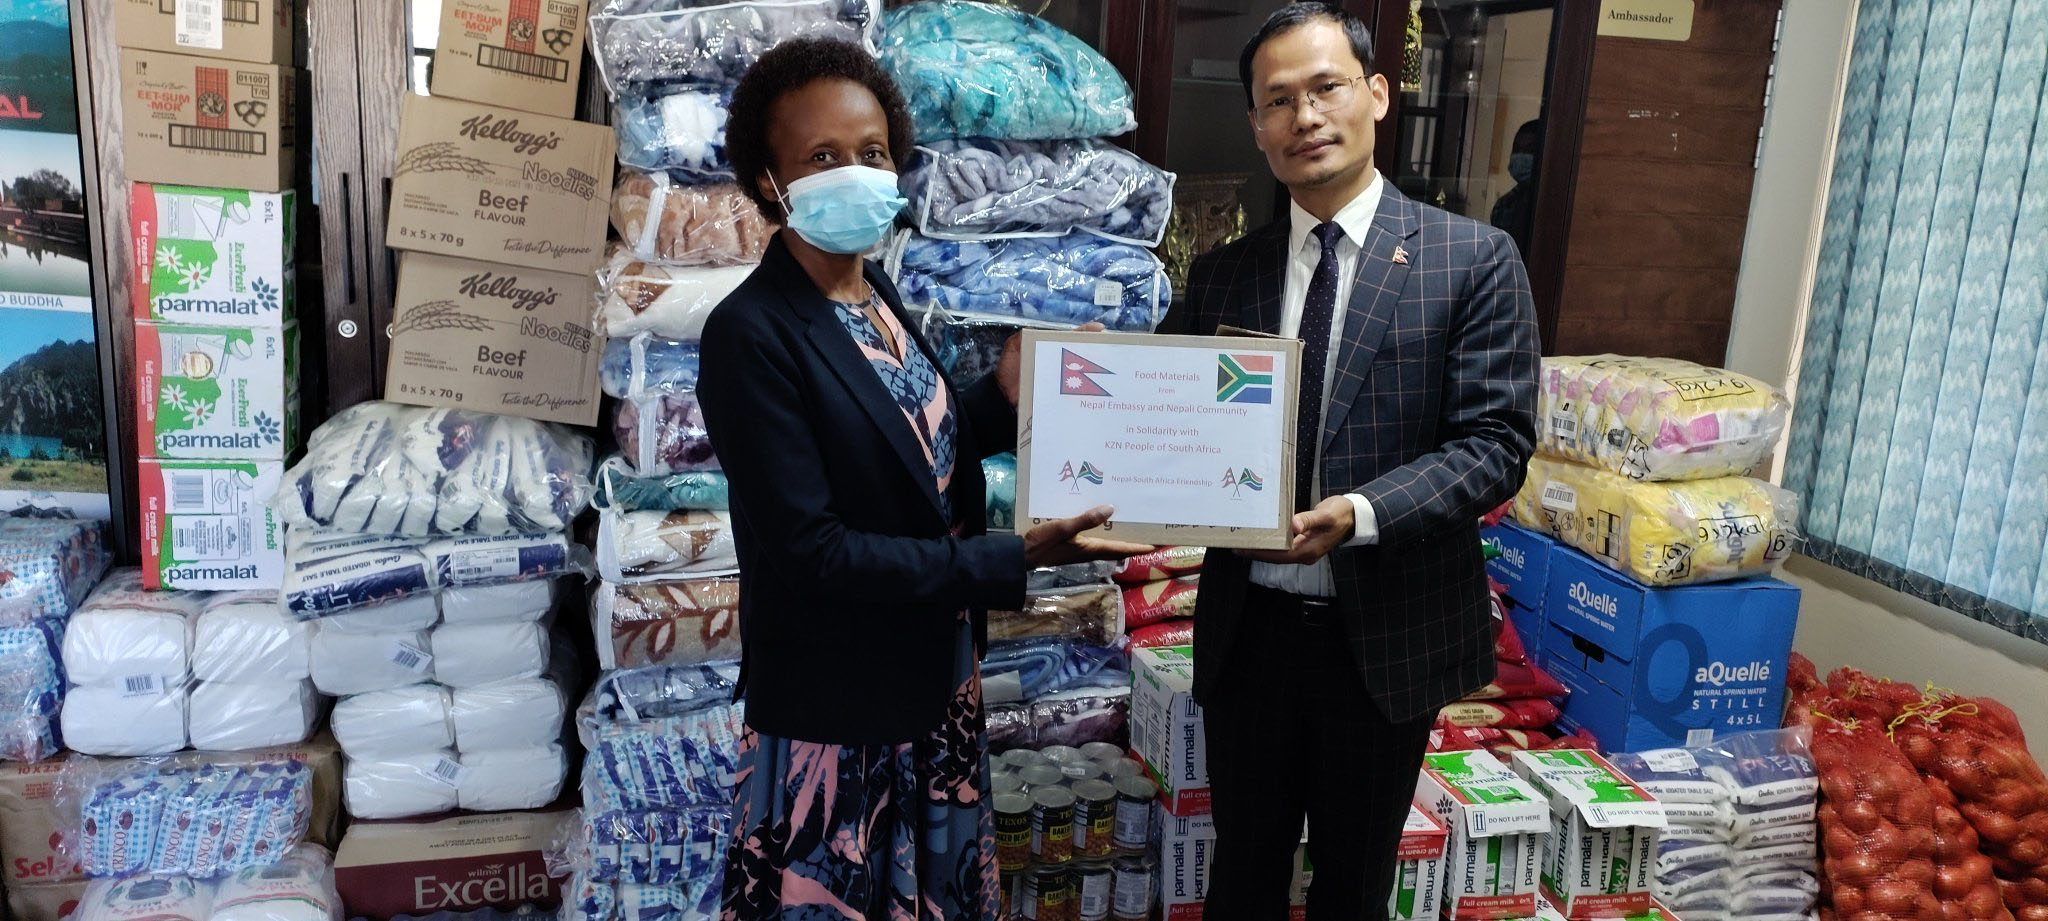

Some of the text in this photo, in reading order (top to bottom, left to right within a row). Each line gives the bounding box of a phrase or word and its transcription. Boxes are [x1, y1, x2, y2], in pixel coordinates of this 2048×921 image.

[454, 9, 503, 26] EET-SUM
[549, 3, 577, 14] 011007
[1607, 9, 1674, 24] Ambassador
[238, 74, 268, 84] 011007
[137, 90, 190, 103] EET-SUM
[459, 114, 562, 155] Kellogg's
[522, 160, 595, 201] Noodles
[478, 189, 530, 213] Beef
[264, 200, 274, 223] 6x1L
[474, 209, 526, 226] FLAVOUR
[400, 226, 407, 237] 8
[410, 230, 417, 238] x
[420, 230, 427, 239] 5
[440, 233, 454, 243] 70
[456, 237, 464, 247] g
[537, 240, 592, 260] Difference
[234, 242, 247, 293] EverFresh
[10, 293, 63, 308] BUDDHA
[459, 272, 558, 311] Kellogg's
[158, 298, 259, 315] parmalat
[520, 316, 592, 353] Noodles
[265, 336, 275, 359] 6x1L
[477, 345, 527, 366] Beef
[472, 365, 525, 380] FLAVOUR
[1135, 370, 1200, 382] Food Materials
[400, 383, 407, 393] 8
[420, 387, 426, 396] 5
[429, 389, 436, 397] x
[439, 389, 454, 399] 70
[455, 392, 463, 401] g
[238, 378, 249, 428] EverFresh
[535, 393, 588, 411] Difference
[1080, 400, 1248, 417] Nepal Embassy and Nepali Community
[1126, 425, 1199, 438] in Solidarity with
[163, 433, 261, 450] parmalat
[1104, 441, 1221, 454] KZN People of South Africa
[149, 496, 159, 557] full cream milk
[311, 536, 381, 553] IODATED TABLE SALT
[453, 534, 521, 546] IODATED TABLE SALT
[168, 564, 259, 582] parmalat
[301, 559, 372, 582] IODATED TABLE SALT
[1568, 581, 1618, 618] aQuellé
[1567, 603, 1615, 633] NATURAL SPRING WATER
[1695, 660, 1771, 686] aQuellé
[1694, 687, 1767, 697] NATURAL SPRING WATER
[1727, 714, 1734, 725] 4
[1737, 716, 1743, 725] x
[1183, 723, 1196, 781] parmalat
[18, 767, 30, 775] 10
[1525, 814, 1541, 822] HERE
[1768, 815, 1788, 823] IODATED
[112, 831, 128, 871] TRINCO
[163, 831, 183, 869] TRINCO
[1406, 847, 1439, 856] full cream
[1555, 818, 1569, 895] parmalat
[1174, 840, 1185, 897] parmalat
[1464, 838, 1477, 894] parmalat
[1581, 835, 1592, 888] parmalat
[1637, 836, 1650, 888] parmalat
[467, 868, 502, 878] wilmar
[414, 862, 550, 910] Excella
[1422, 859, 1437, 913] parmalat
[1574, 897, 1588, 905] full
